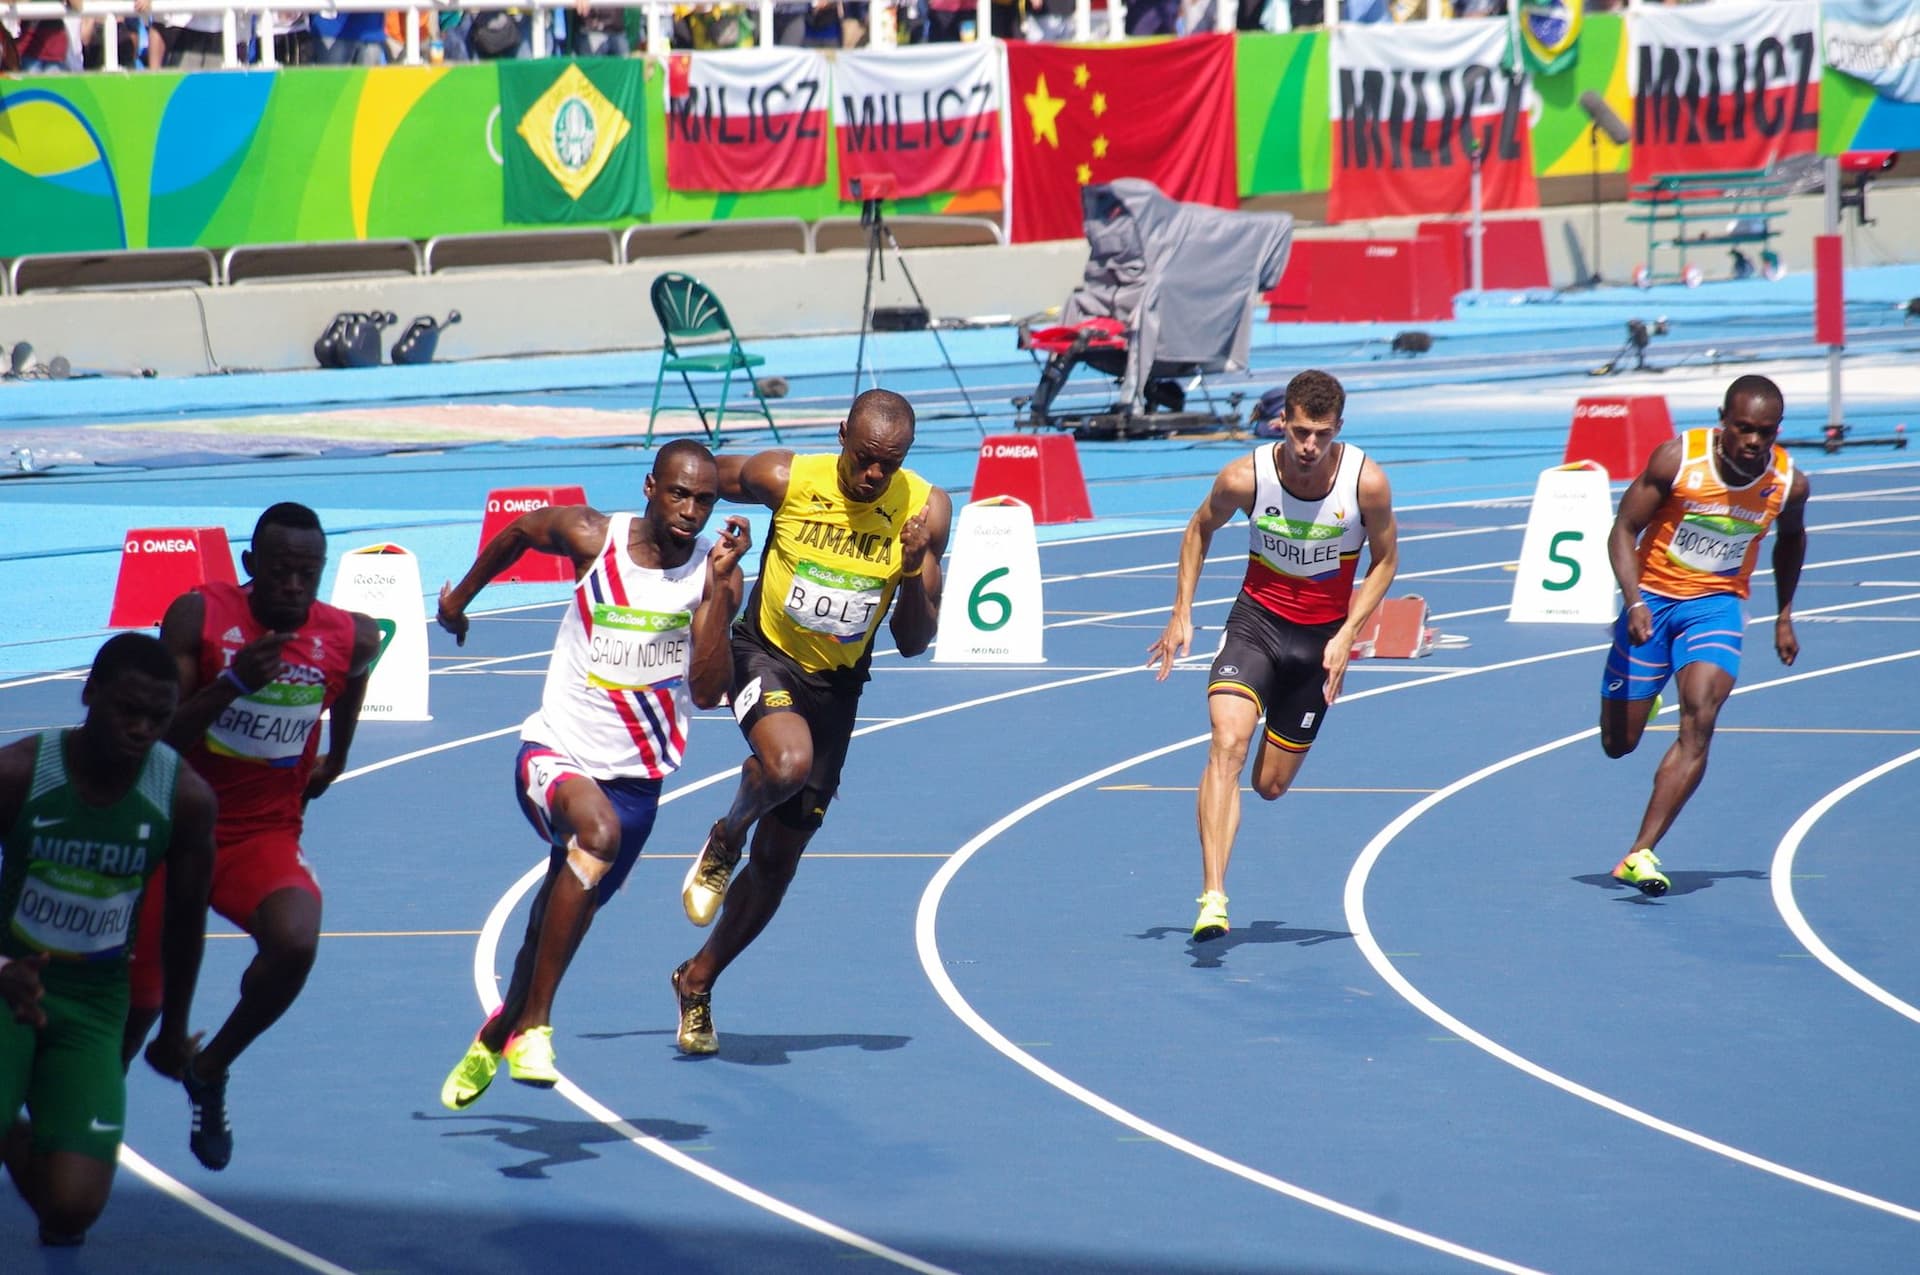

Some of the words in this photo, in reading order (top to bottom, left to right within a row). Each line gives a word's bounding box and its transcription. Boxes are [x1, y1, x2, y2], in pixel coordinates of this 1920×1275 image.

[1636, 32, 1818, 144] MILICZ
[670, 81, 820, 143] MILICZ
[842, 84, 992, 152] MILICZ
[1340, 65, 1524, 168] MILICZ
[1588, 404, 1630, 418] OMEGA
[996, 445, 1038, 458] OMEGA
[503, 499, 549, 512] OMEGA
[143, 539, 197, 553] OMEGA
[794, 520, 892, 566] JAMAICA
[1263, 534, 1338, 566] BORLEE
[1542, 531, 1584, 591] 5
[807, 566, 845, 584] Rio2016
[788, 585, 878, 624] BOLT
[968, 567, 1012, 631] 6
[607, 611, 647, 626] Rio2016
[591, 636, 632, 667] SAIDY
[637, 640, 685, 668] NDURE
[971, 647, 1009, 655] MONDO
[215, 707, 314, 744] GREAUX
[359, 704, 393, 712] ONDO
[32, 836, 147, 874] NIGERIA
[22, 889, 131, 937] ODUDURU
